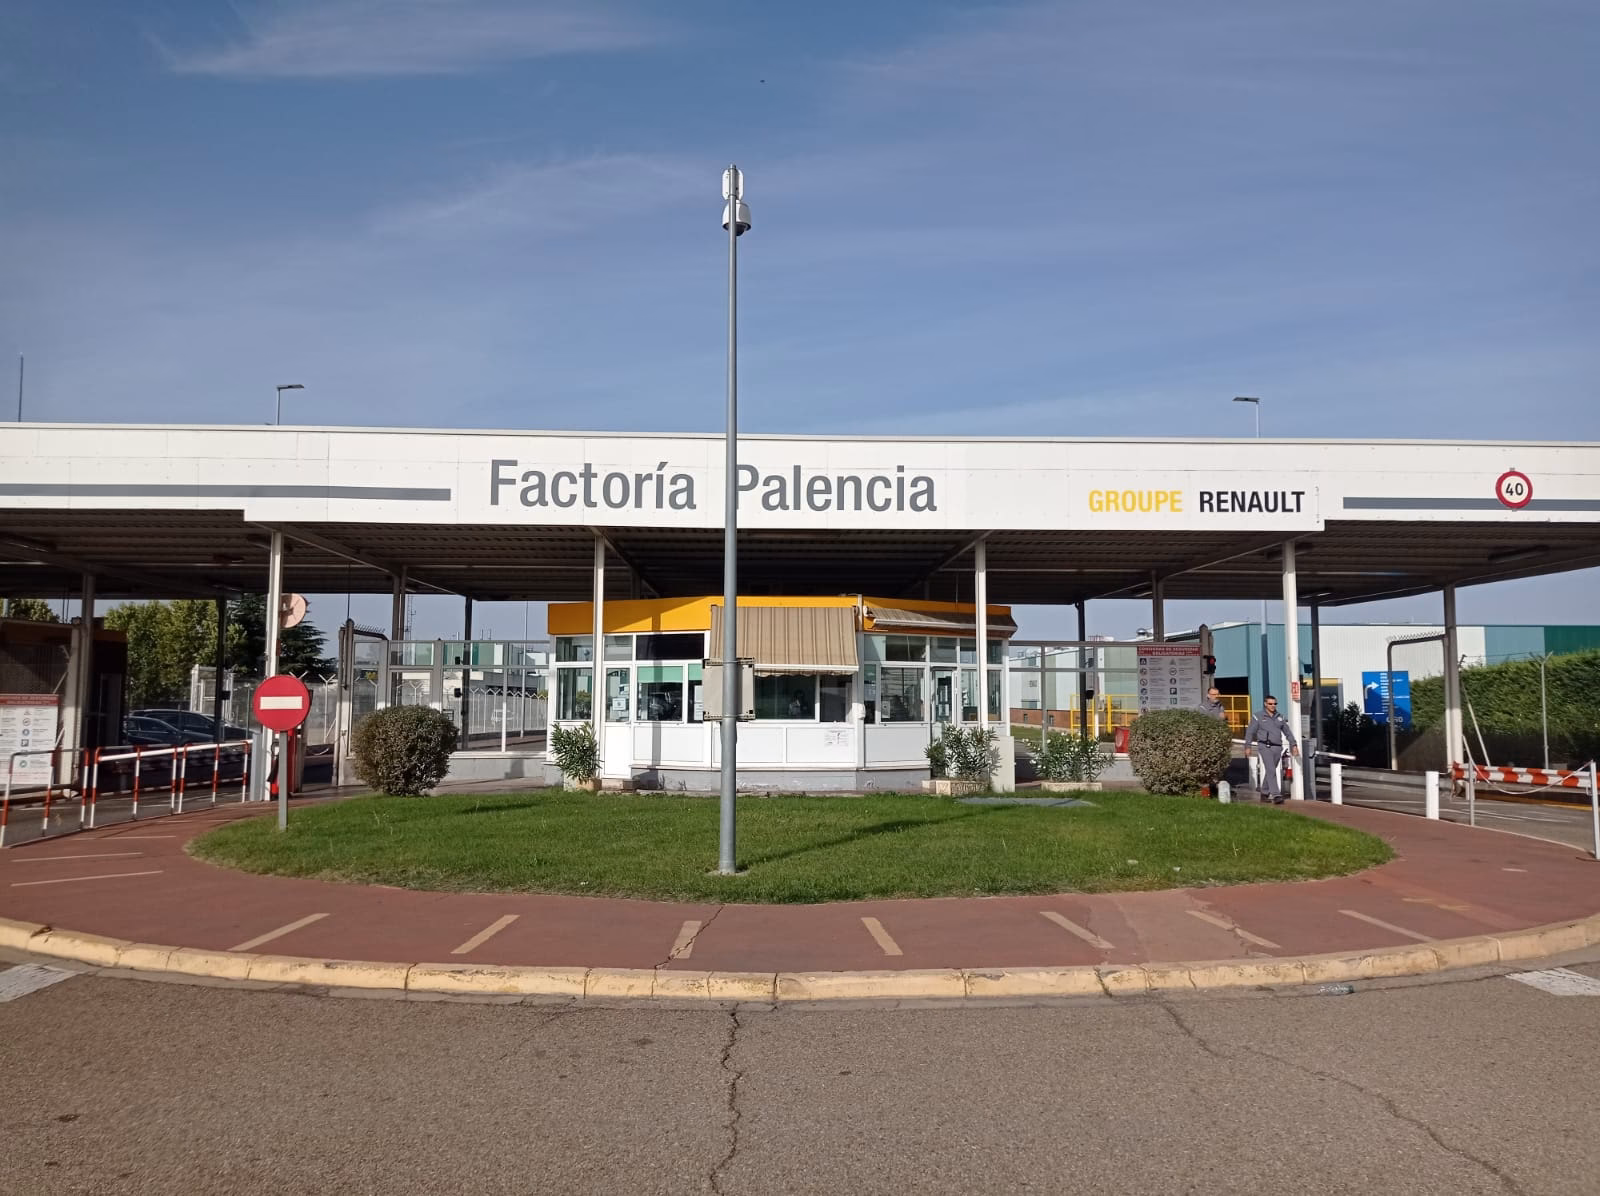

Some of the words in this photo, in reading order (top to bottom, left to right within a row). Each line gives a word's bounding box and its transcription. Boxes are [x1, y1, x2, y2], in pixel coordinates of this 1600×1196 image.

[490, 459, 697, 510] Factoría
[735, 463, 938, 513] Palencia
[1505, 482, 1524, 496] 40
[1088, 489, 1183, 513] GROUPE
[1199, 490, 1306, 513] RENAULT
